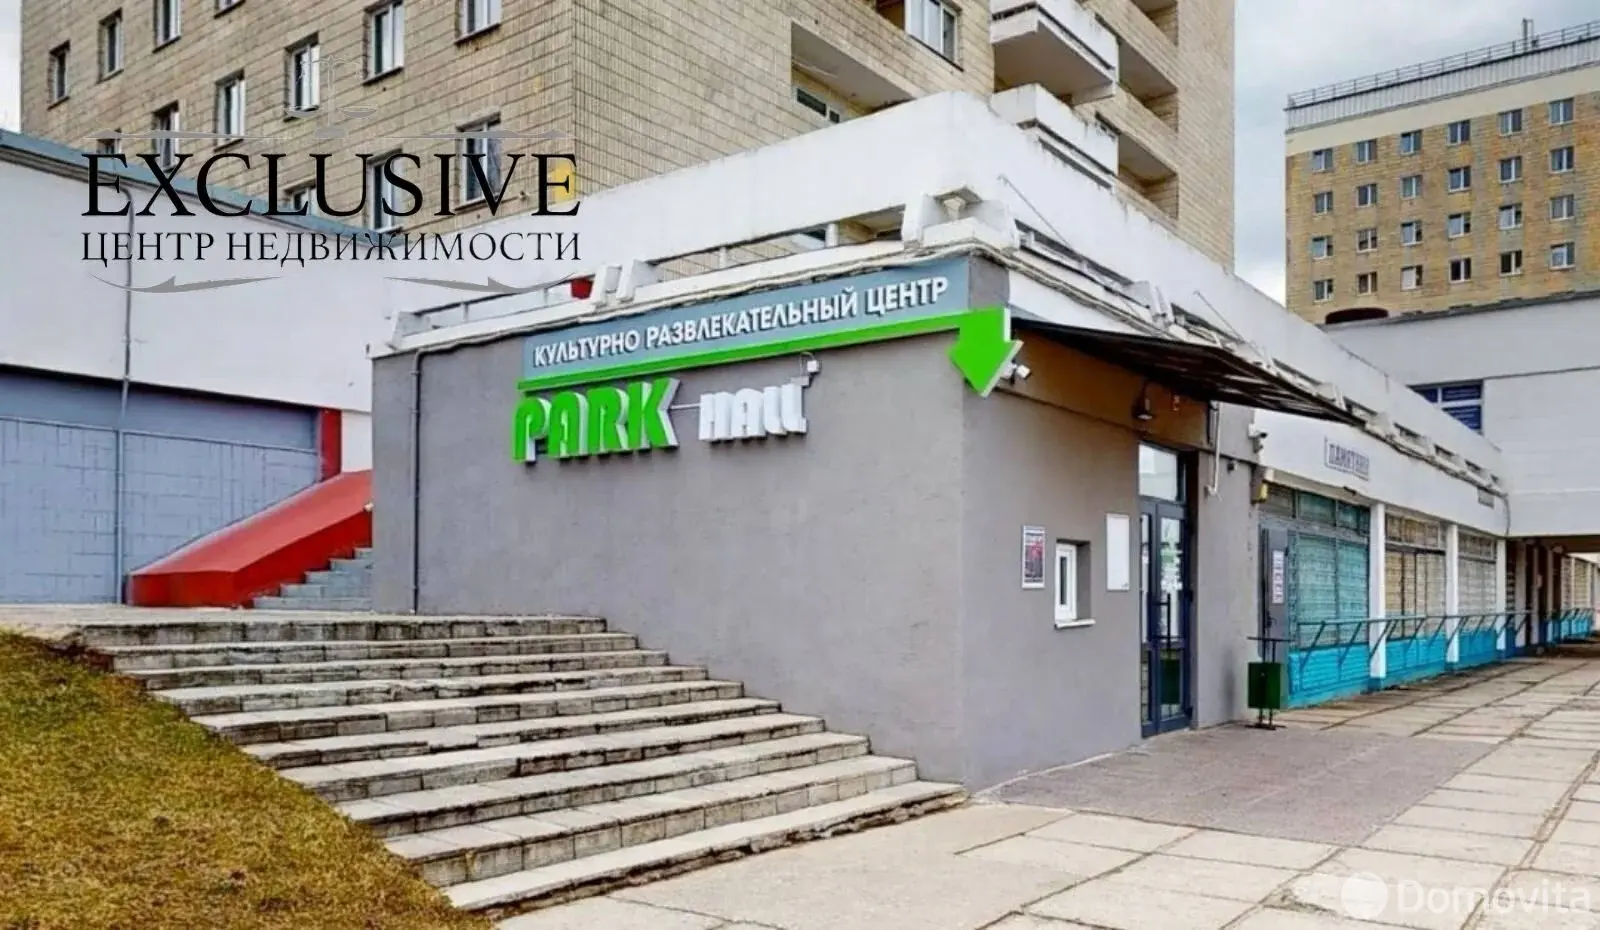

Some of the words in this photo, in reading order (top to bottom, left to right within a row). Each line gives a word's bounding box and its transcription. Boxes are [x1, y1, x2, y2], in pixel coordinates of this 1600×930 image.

[533, 329, 642, 367] КУЛЬТУРНО
[646, 288, 859, 347] РАЗВЛЕКАТЕЛЬНЫЙ
[864, 276, 949, 316] ЦЕНТР
[512, 377, 680, 463] PARK
[699, 384, 807, 442] HALL
